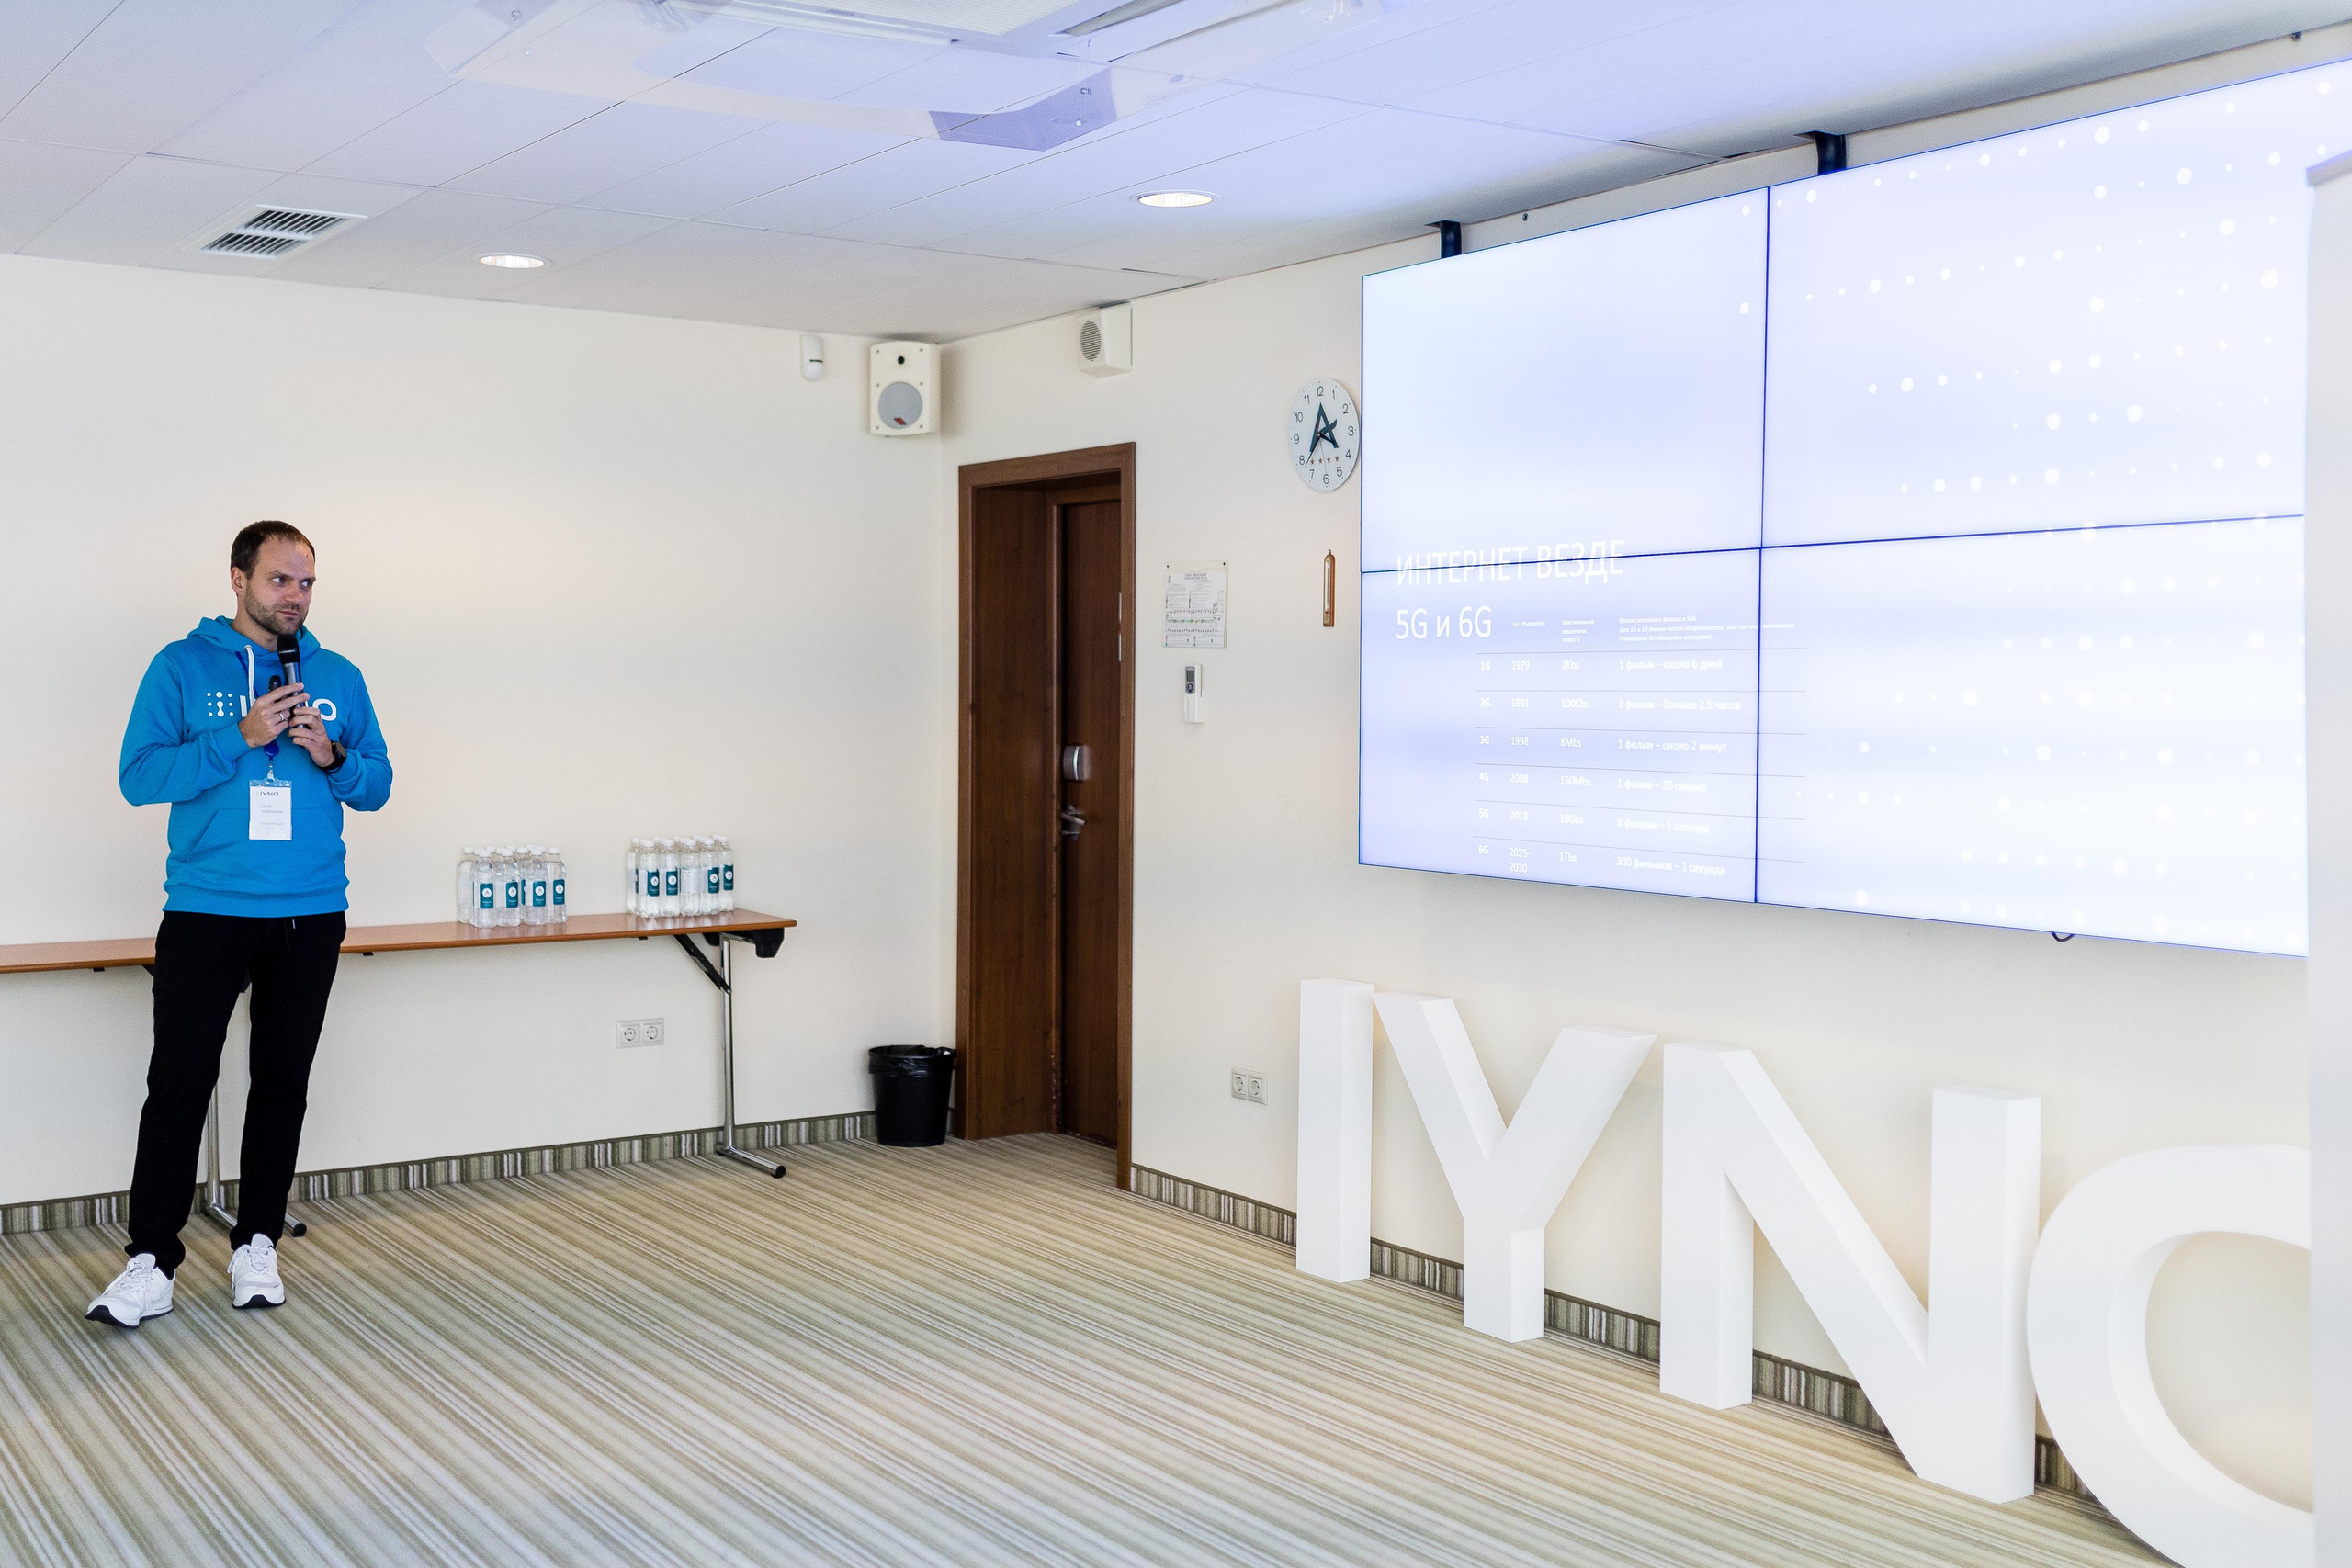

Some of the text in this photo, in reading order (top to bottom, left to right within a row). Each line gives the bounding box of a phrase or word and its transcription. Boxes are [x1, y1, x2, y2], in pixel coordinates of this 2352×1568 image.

[1317, 386, 1324, 397] 12
[1332, 391, 1336, 400] 1
[1305, 395, 1310, 404] 11
[1342, 404, 1349, 414] 2
[1295, 412, 1304, 423] 10
[1348, 426, 1354, 436] 3
[1294, 434, 1299, 444] 9
[1346, 449, 1351, 458] 4
[1299, 456, 1305, 465] 8
[1309, 469, 1315, 479] 7
[1337, 467, 1342, 477] 5
[1323, 474, 1329, 484] 6
[1396, 539, 1625, 586] ИНТЕРНЕТ ВЕЗДЕ
[1396, 605, 1491, 639] 5G и 6G
[1481, 661, 1490, 670] 1G
[1512, 660, 1530, 670] 1979
[1562, 660, 1579, 670] 2Kbs
[1619, 660, 1623, 669] 1
[1626, 660, 1654, 671] фильм
[1691, 659, 1698, 669] 6
[1700, 659, 1723, 671] дней
[1480, 698, 1490, 707] 2G
[1511, 698, 1529, 707] 1991
[1562, 698, 1589, 708] 100Kbs
[1618, 699, 1623, 708] 1
[1625, 699, 1654, 711] фильм
[1664, 699, 1697, 709] больше
[1699, 699, 1713, 710] 2.5
[1714, 701, 1740, 709] часов
[240, 695, 336, 721] IO
[1480, 736, 1489, 744] 3G
[1511, 737, 1529, 745] 1998
[1561, 738, 1581, 747] 8Mbs
[1619, 739, 1623, 749] 1
[1625, 739, 1653, 750] фильм
[1691, 741, 1696, 750] 2
[1699, 744, 1727, 754] минут
[1479, 772, 1489, 781] 4G
[1510, 773, 1528, 783] 2008
[1561, 776, 1591, 786] 150Mbs
[1618, 778, 1623, 788] 1
[1624, 778, 1653, 790] фильм
[1662, 780, 1673, 790] 20
[1675, 784, 1706, 794] секунд
[1479, 808, 1488, 818] 5G
[1510, 810, 1528, 820] 2018
[1560, 814, 1584, 824] 10Gbs
[1617, 817, 1623, 827] 3
[1624, 818, 1657, 829] фильма
[1667, 821, 1671, 830] 1
[1674, 823, 1710, 834] секунда
[1478, 845, 1488, 854] 6G
[1510, 848, 1530, 857] 2025-
[1560, 852, 1577, 862] 1Tbs
[1510, 863, 1528, 873] 2030
[1617, 856, 1632, 866] 300
[1634, 858, 1672, 870] фильмов
[1682, 862, 1687, 872] 1
[1690, 865, 1725, 876] секунда
